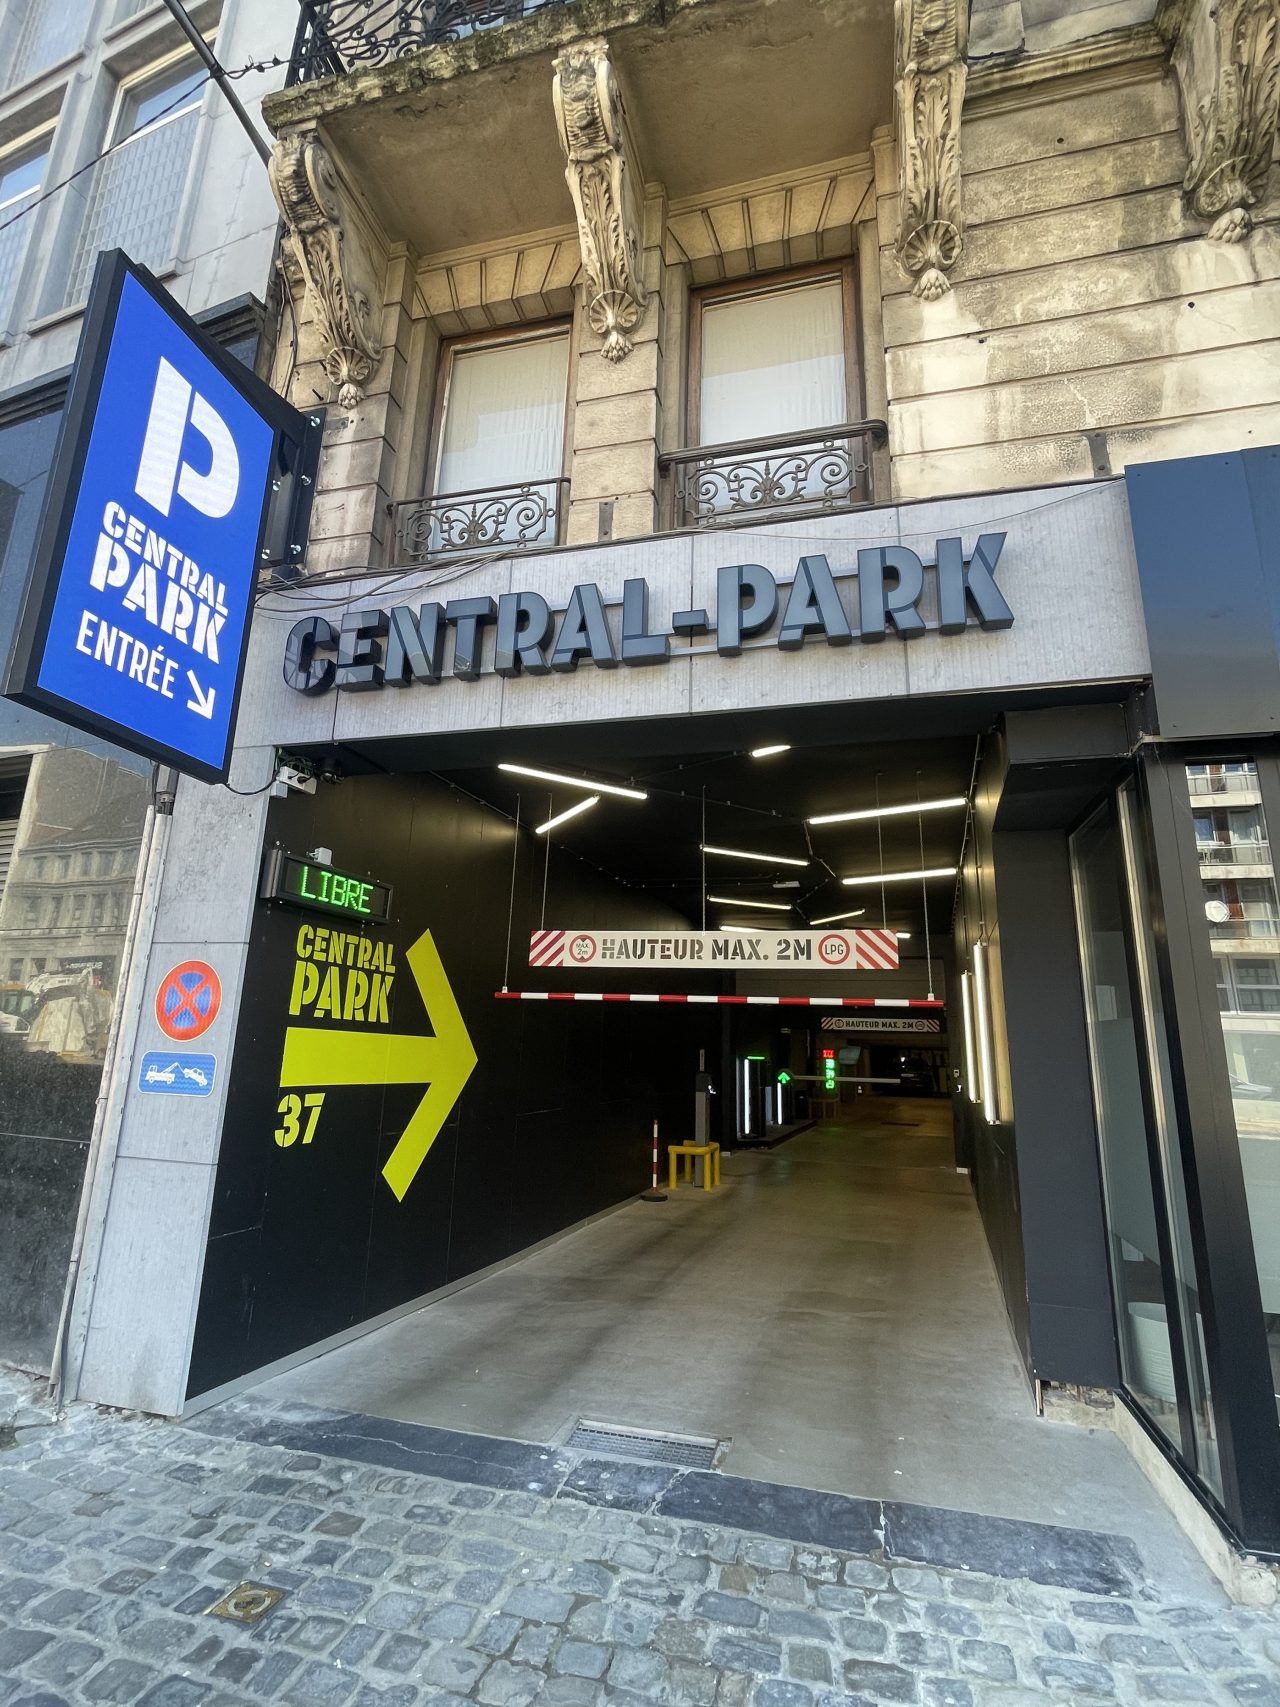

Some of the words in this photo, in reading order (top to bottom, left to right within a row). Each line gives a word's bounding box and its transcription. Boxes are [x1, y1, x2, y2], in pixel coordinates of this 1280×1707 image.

[135, 356, 240, 518] P
[103, 500, 228, 616] CENTRAL
[89, 532, 227, 665] PARK
[76, 610, 179, 699] ENTRÉE
[300, 865, 374, 914] LIBRE
[296, 924, 396, 973] CENTRAL
[577, 948, 588, 956] 2m
[601, 938, 704, 960] HAUTEUR
[711, 938, 769, 960] MAX.
[776, 938, 812, 960] 2M
[824, 944, 844, 955] LPG
[289, 960, 394, 1024] PARK
[845, 1020, 880, 1029] HAUTEUR
[902, 1021, 914, 1029] 2M
[274, 1092, 326, 1148] 37
